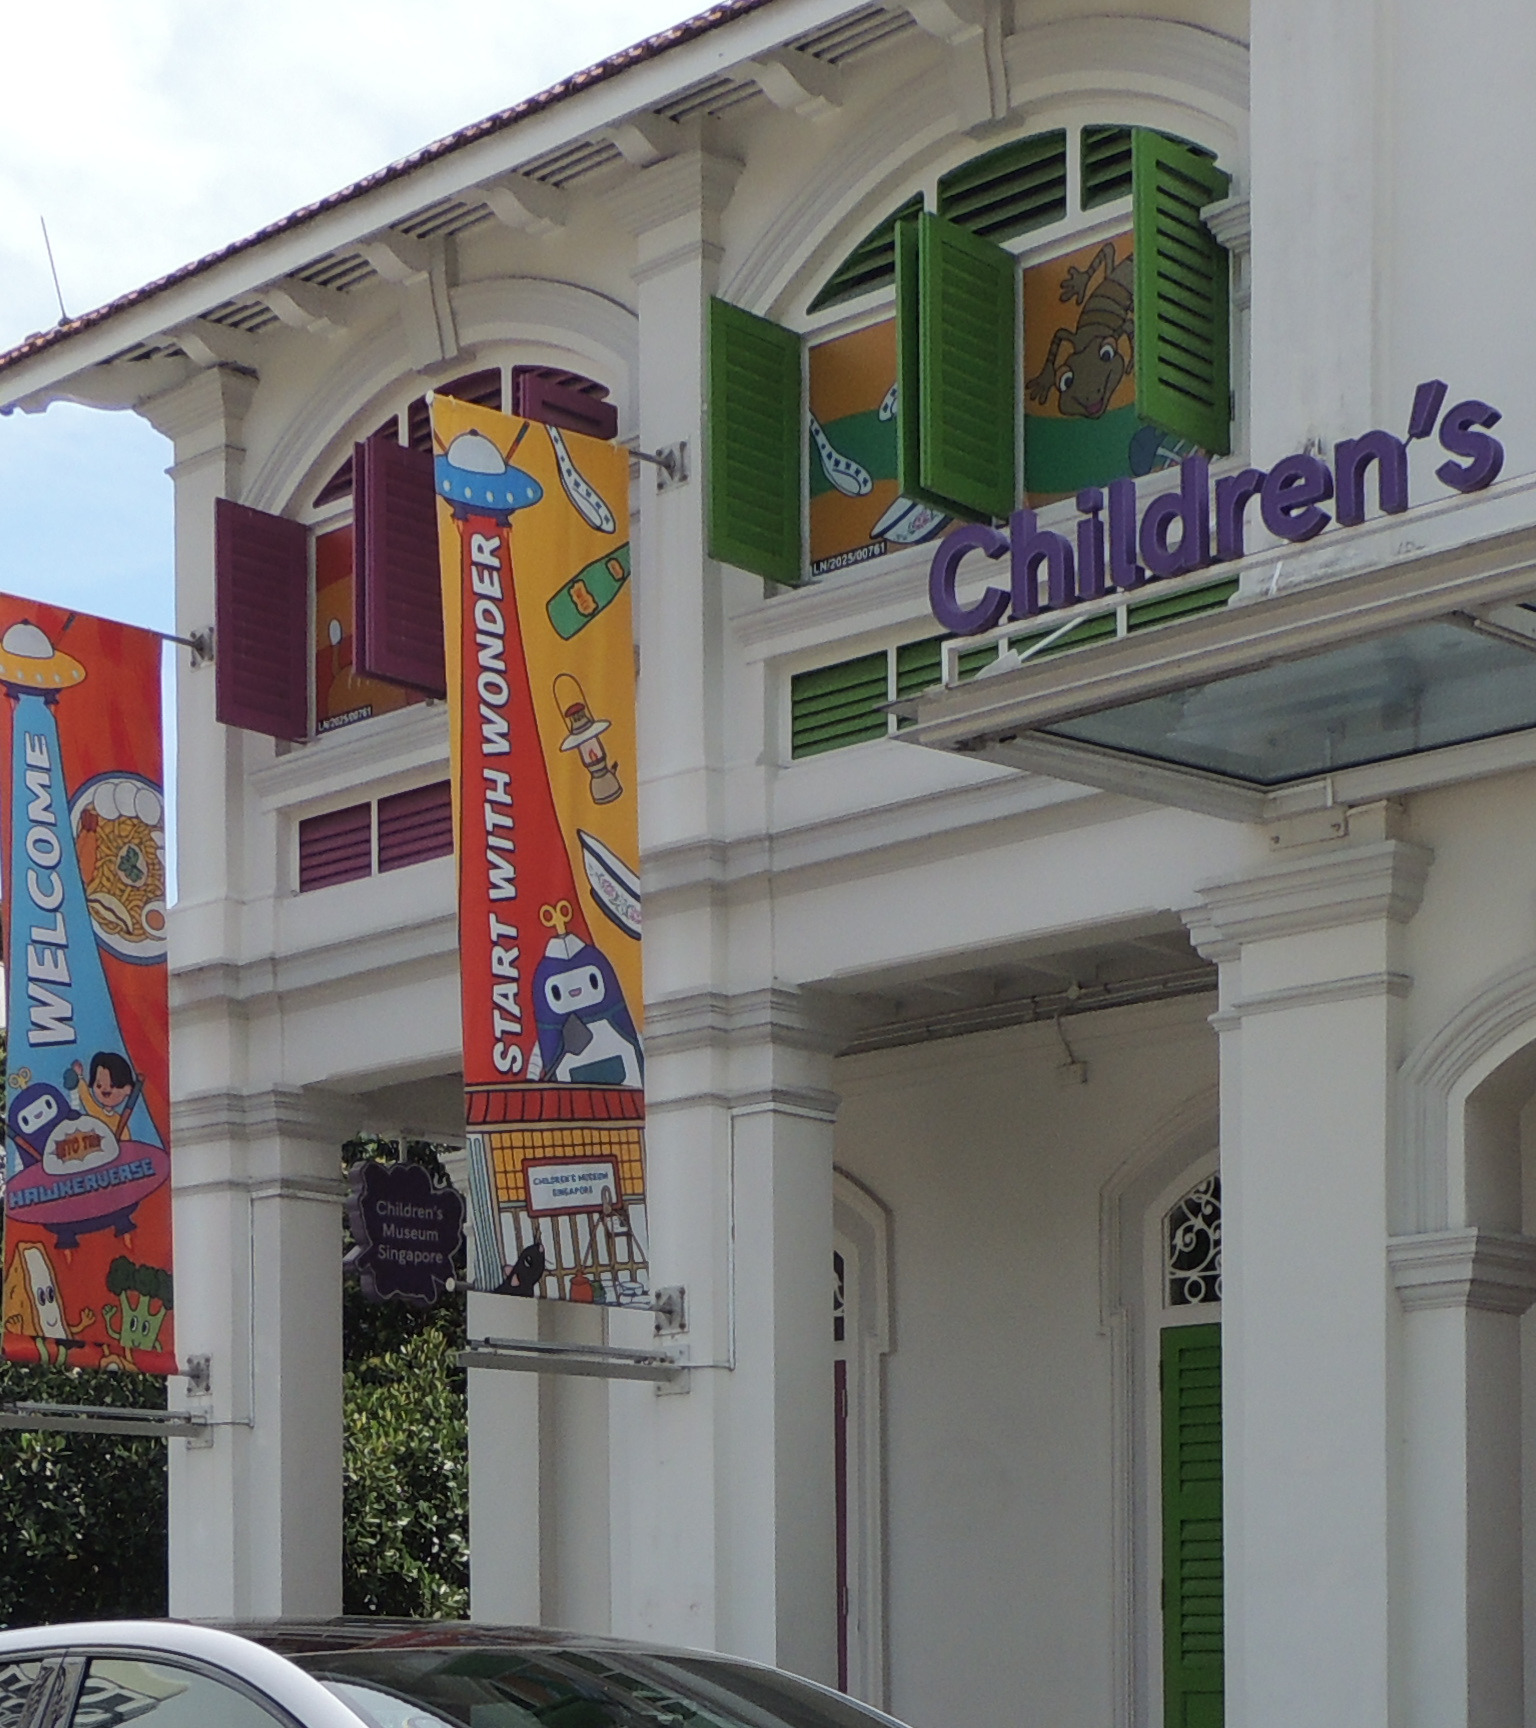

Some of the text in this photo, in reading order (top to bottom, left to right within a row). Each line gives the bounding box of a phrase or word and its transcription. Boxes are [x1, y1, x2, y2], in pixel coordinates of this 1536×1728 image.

[928, 379, 1504, 637] Children's
[470, 531, 524, 1075] START WITH WONDER
[24, 731, 77, 1047] WELCOME
[9, 1157, 157, 1210] HAWKERVERSE
[376, 1200, 444, 1221] Children's
[382, 1223, 439, 1242] Museum
[377, 1244, 443, 1265] Singapore
